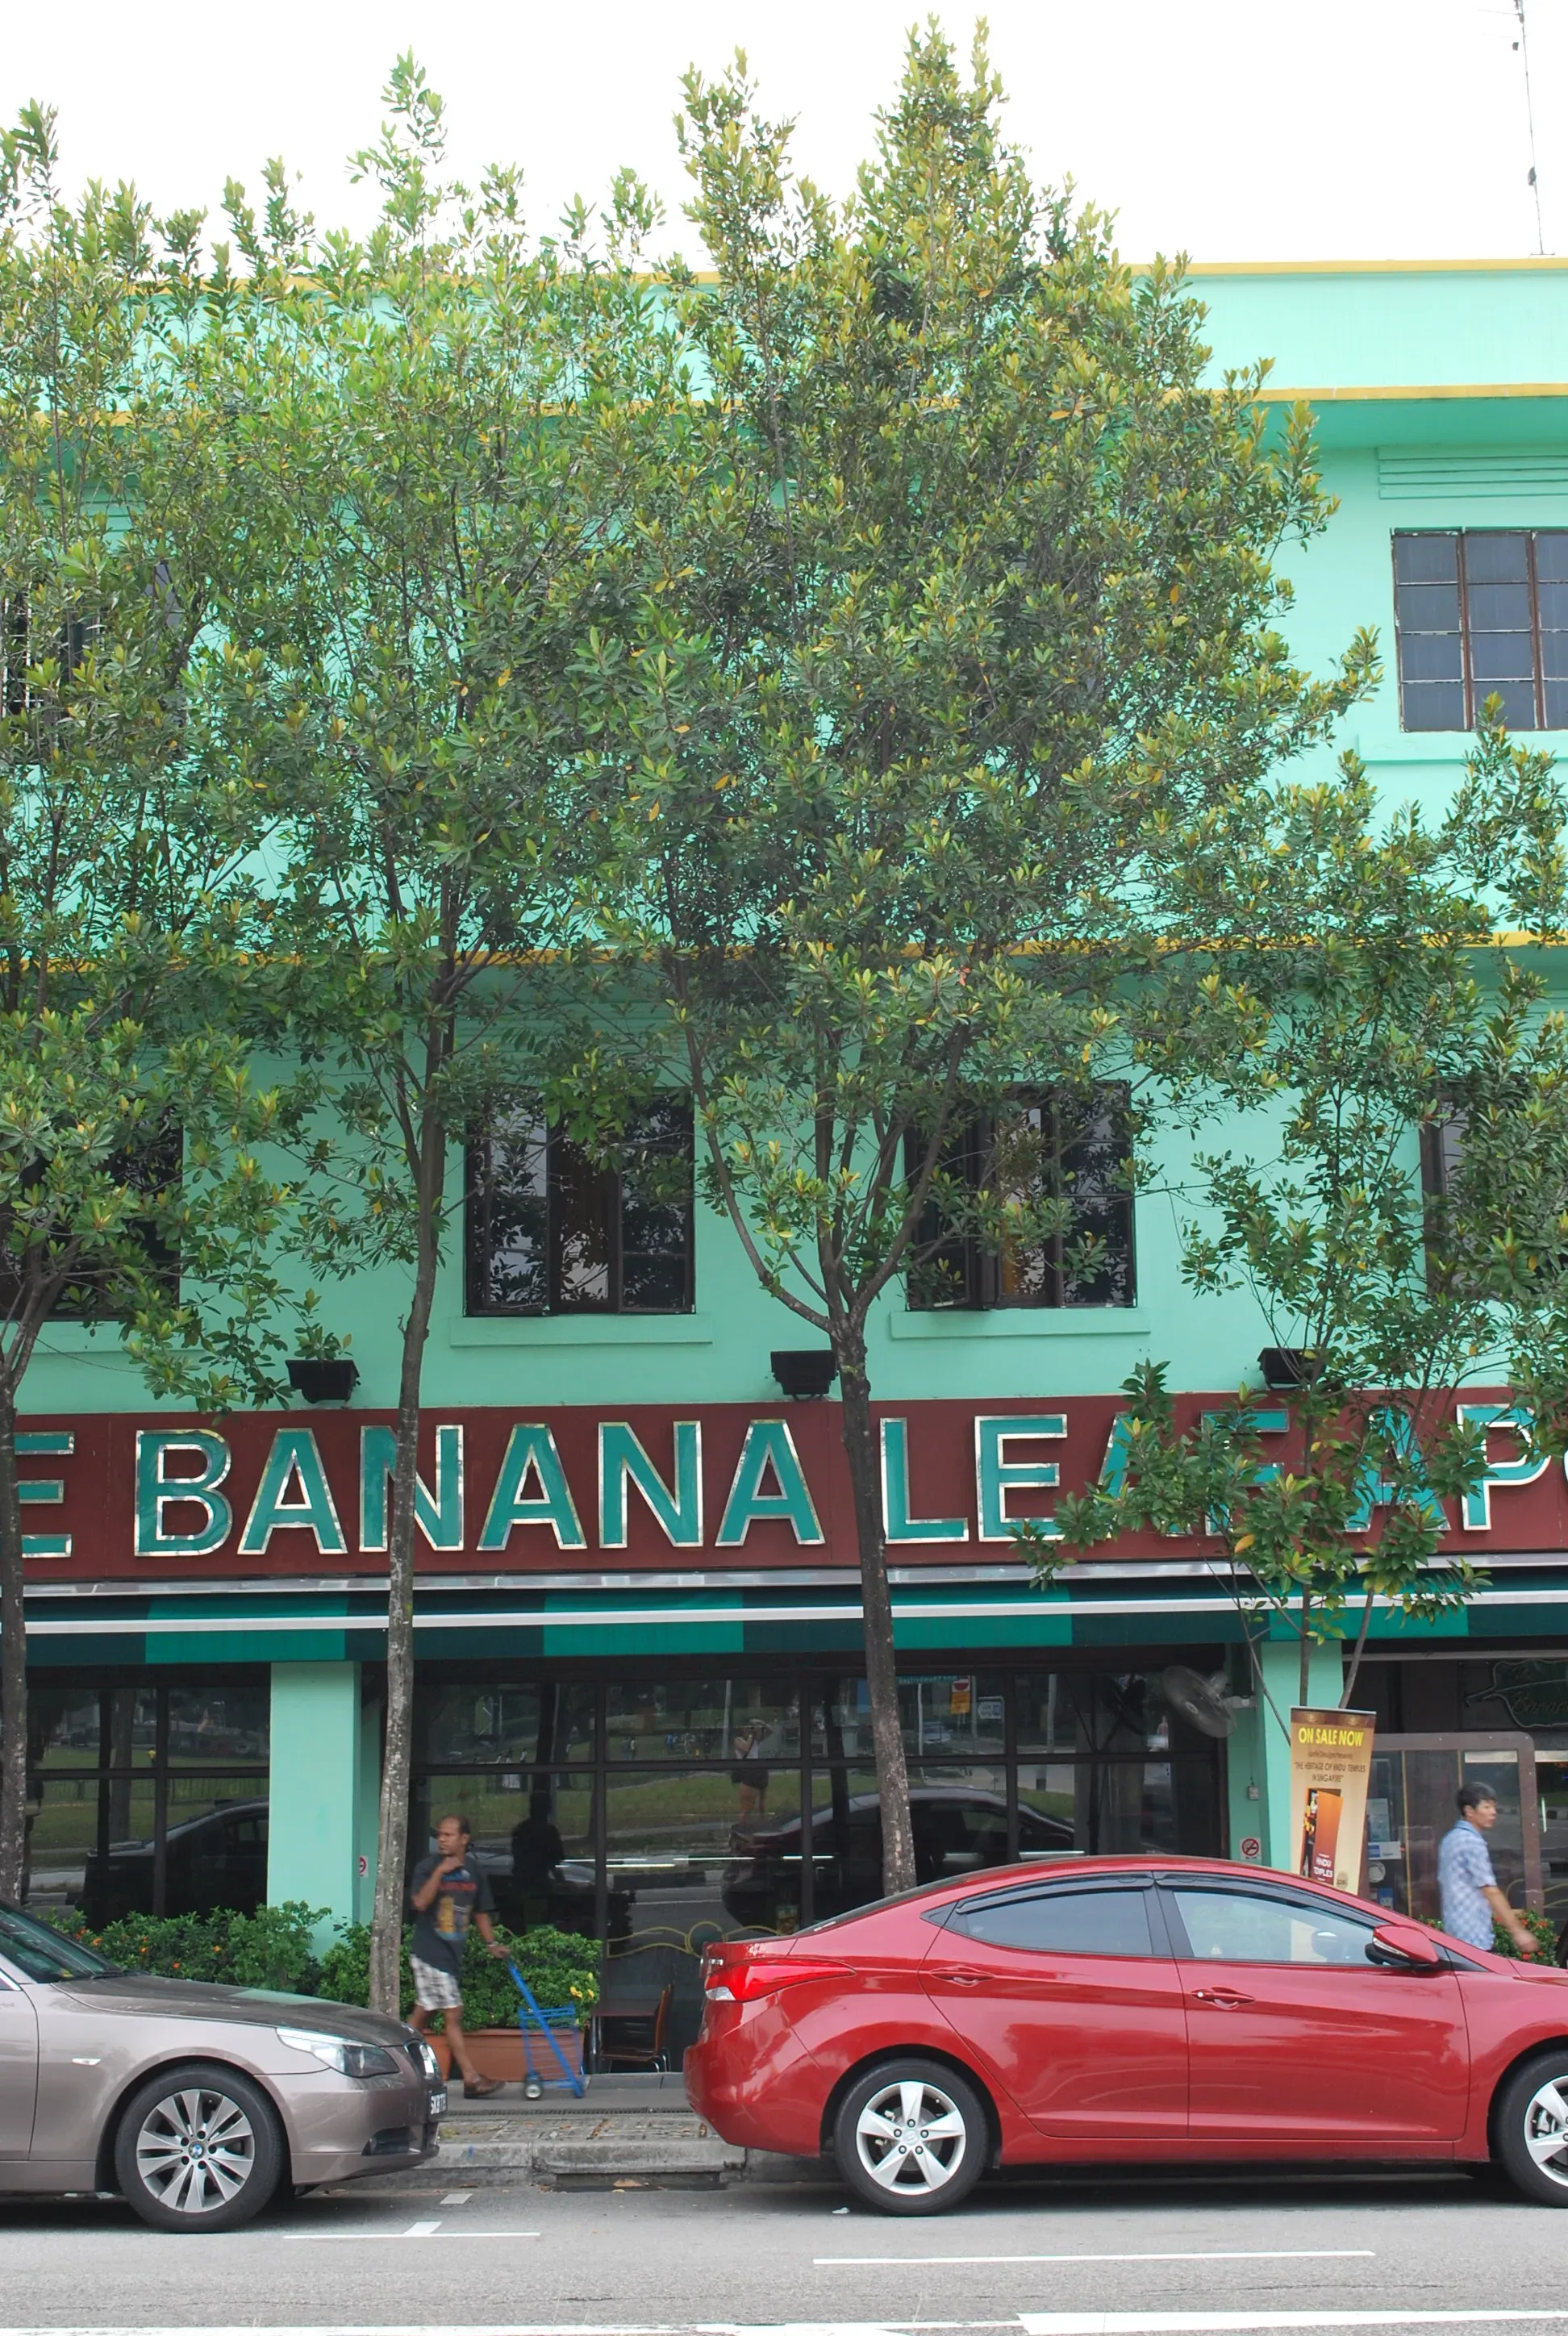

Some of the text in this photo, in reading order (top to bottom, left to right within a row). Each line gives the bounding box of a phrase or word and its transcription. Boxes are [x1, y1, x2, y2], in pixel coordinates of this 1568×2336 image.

[134, 1420, 825, 1557] BANANA
[1344, 1403, 1568, 1533] AP
[1298, 1727, 1364, 1746] ON SALE NOW
